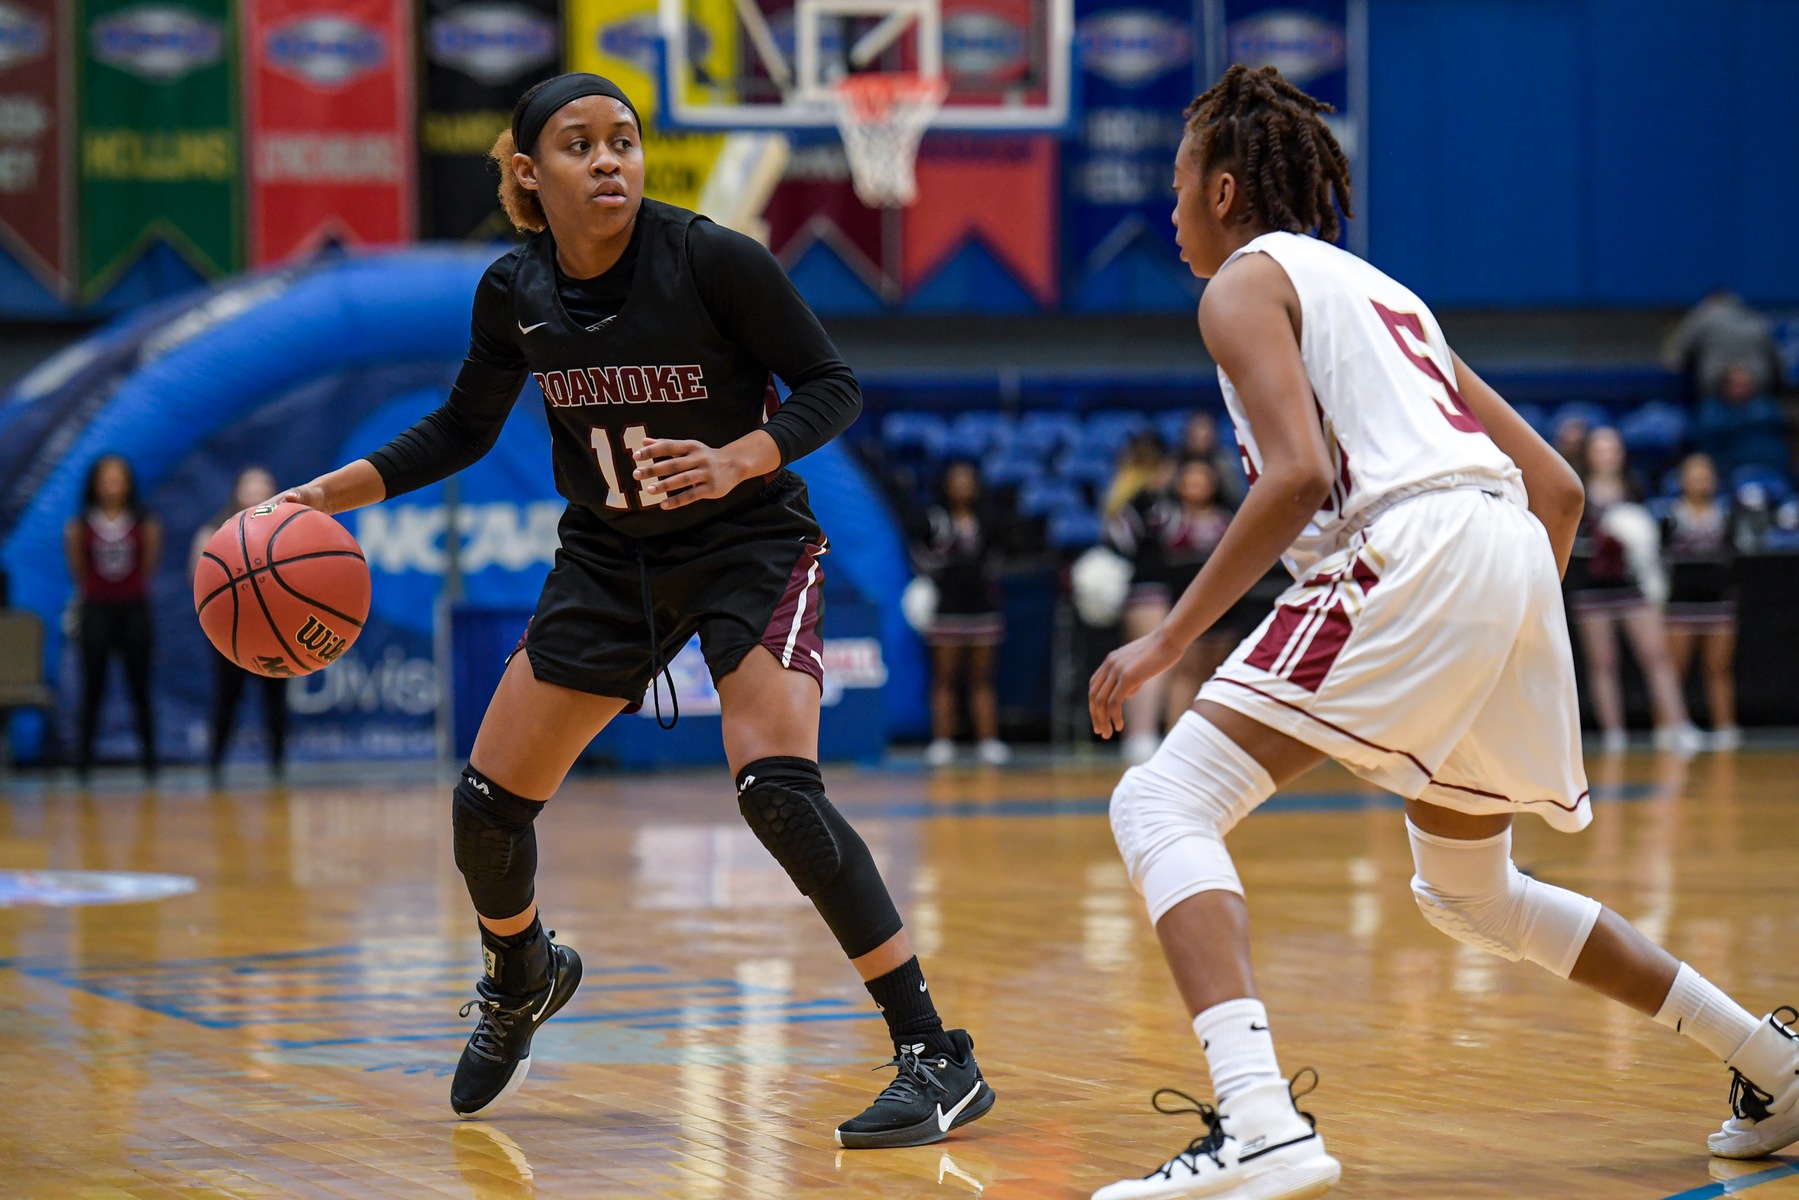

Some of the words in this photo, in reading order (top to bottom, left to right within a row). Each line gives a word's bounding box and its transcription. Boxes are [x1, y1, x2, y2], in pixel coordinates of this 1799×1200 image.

[532, 364, 708, 408] ROANOKE
[1368, 297, 1489, 437] 5
[589, 423, 669, 511] 11
